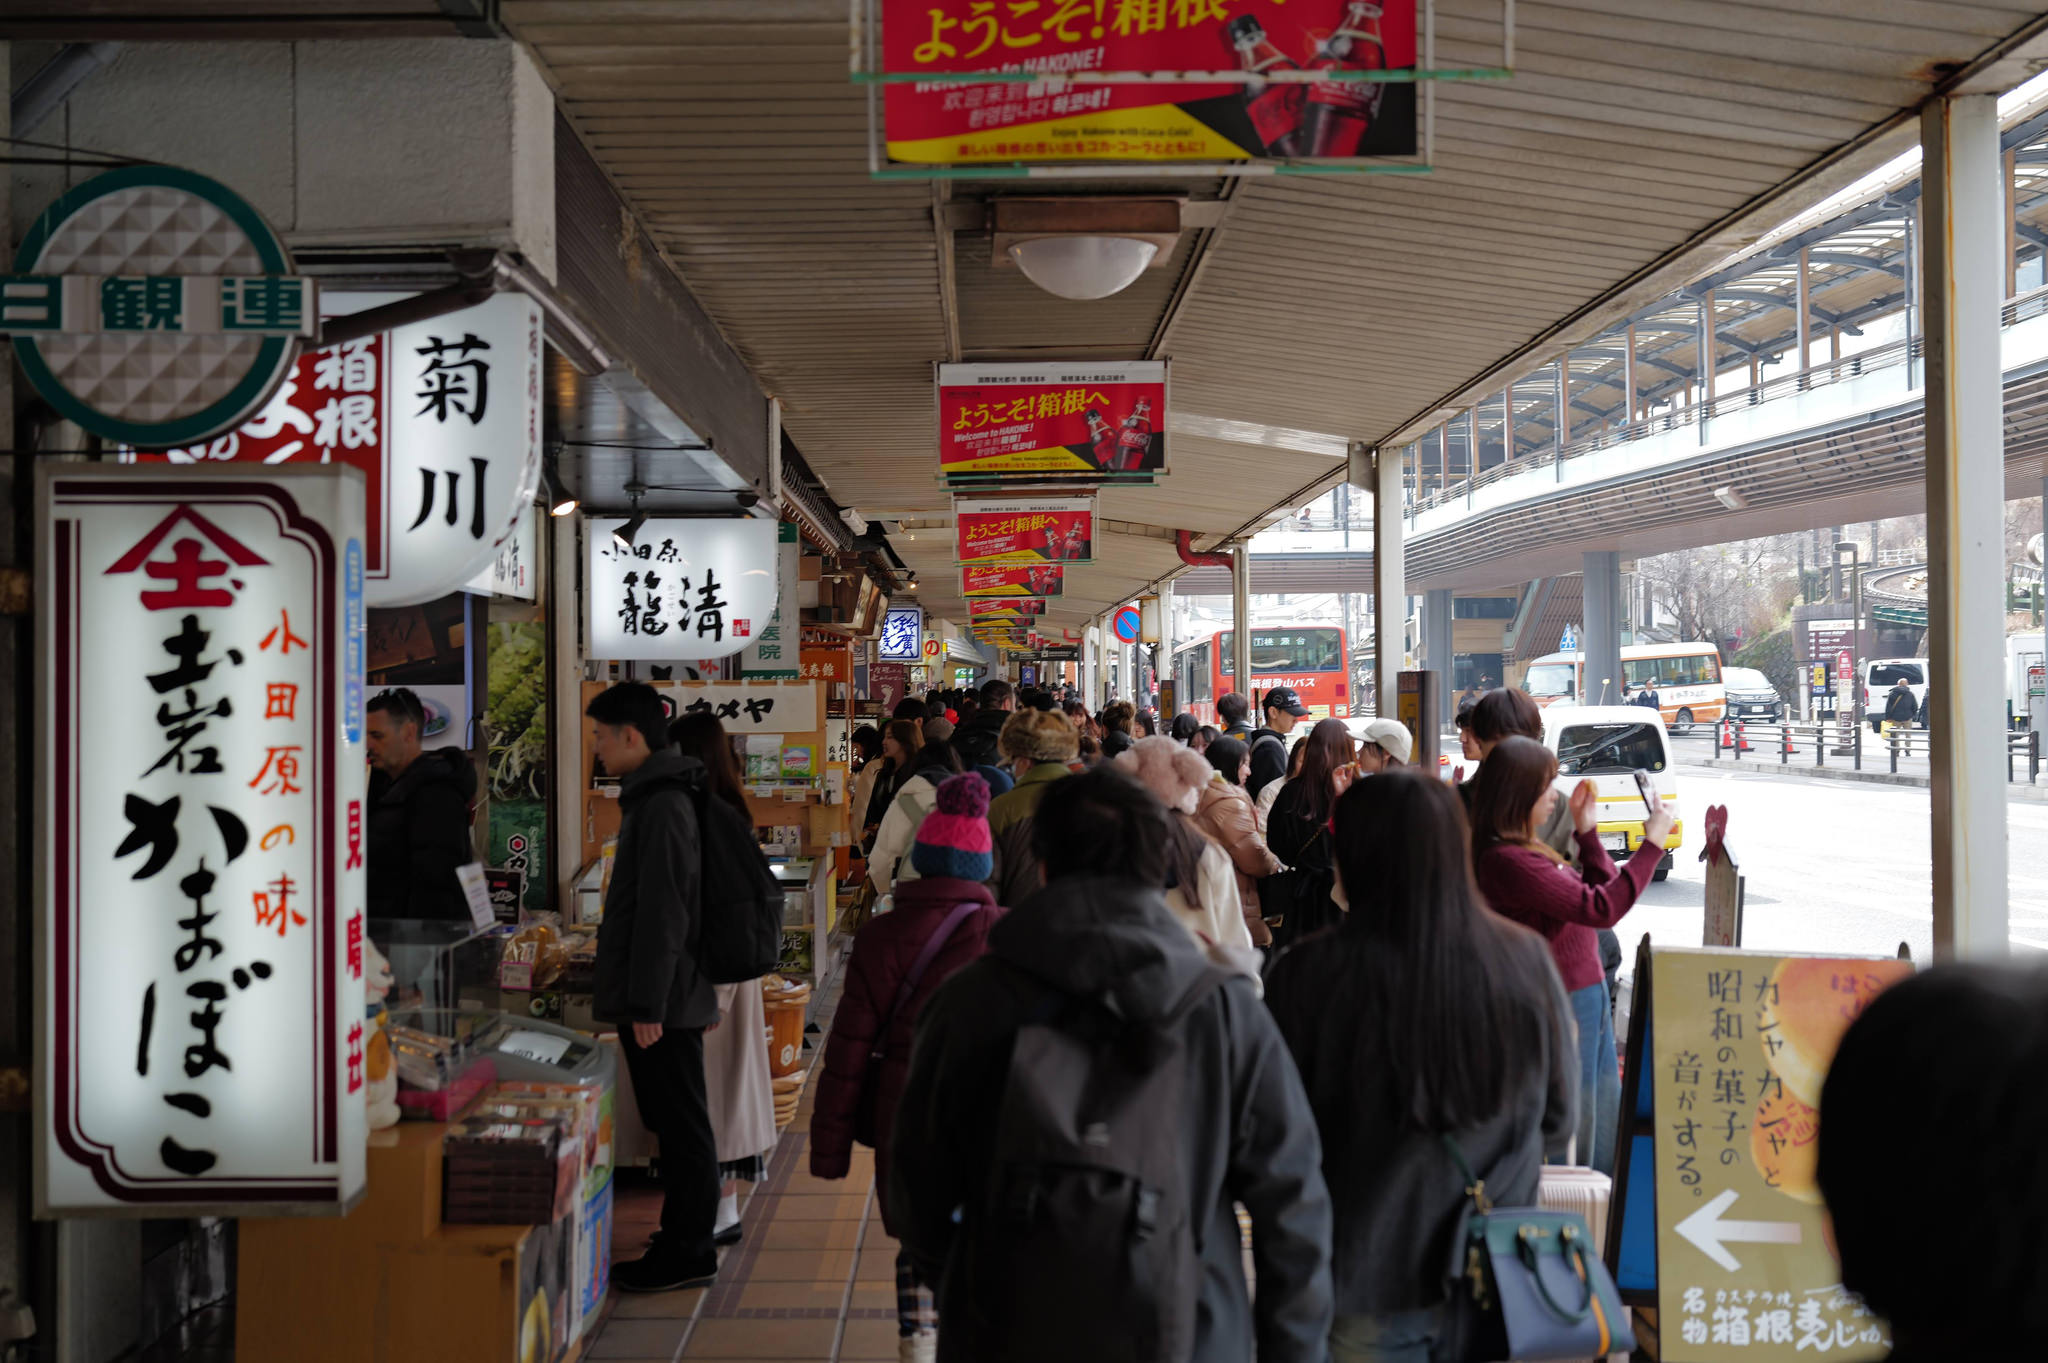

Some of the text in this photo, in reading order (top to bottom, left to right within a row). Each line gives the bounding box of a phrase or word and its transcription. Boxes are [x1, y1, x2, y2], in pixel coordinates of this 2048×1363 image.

[1024, 47, 1105, 74] HAKONE!
[408, 333, 491, 540] 菊川
[953, 388, 1111, 431] ようこそ!箱根へ
[954, 422, 1034, 443] Welcome to HAKONE!
[248, 607, 310, 937] 小田原の味
[1707, 969, 1746, 1166] 昭和の菓子の
[1671, 1051, 1704, 1197] 音がする。
[1682, 1287, 1707, 1345] 名物
